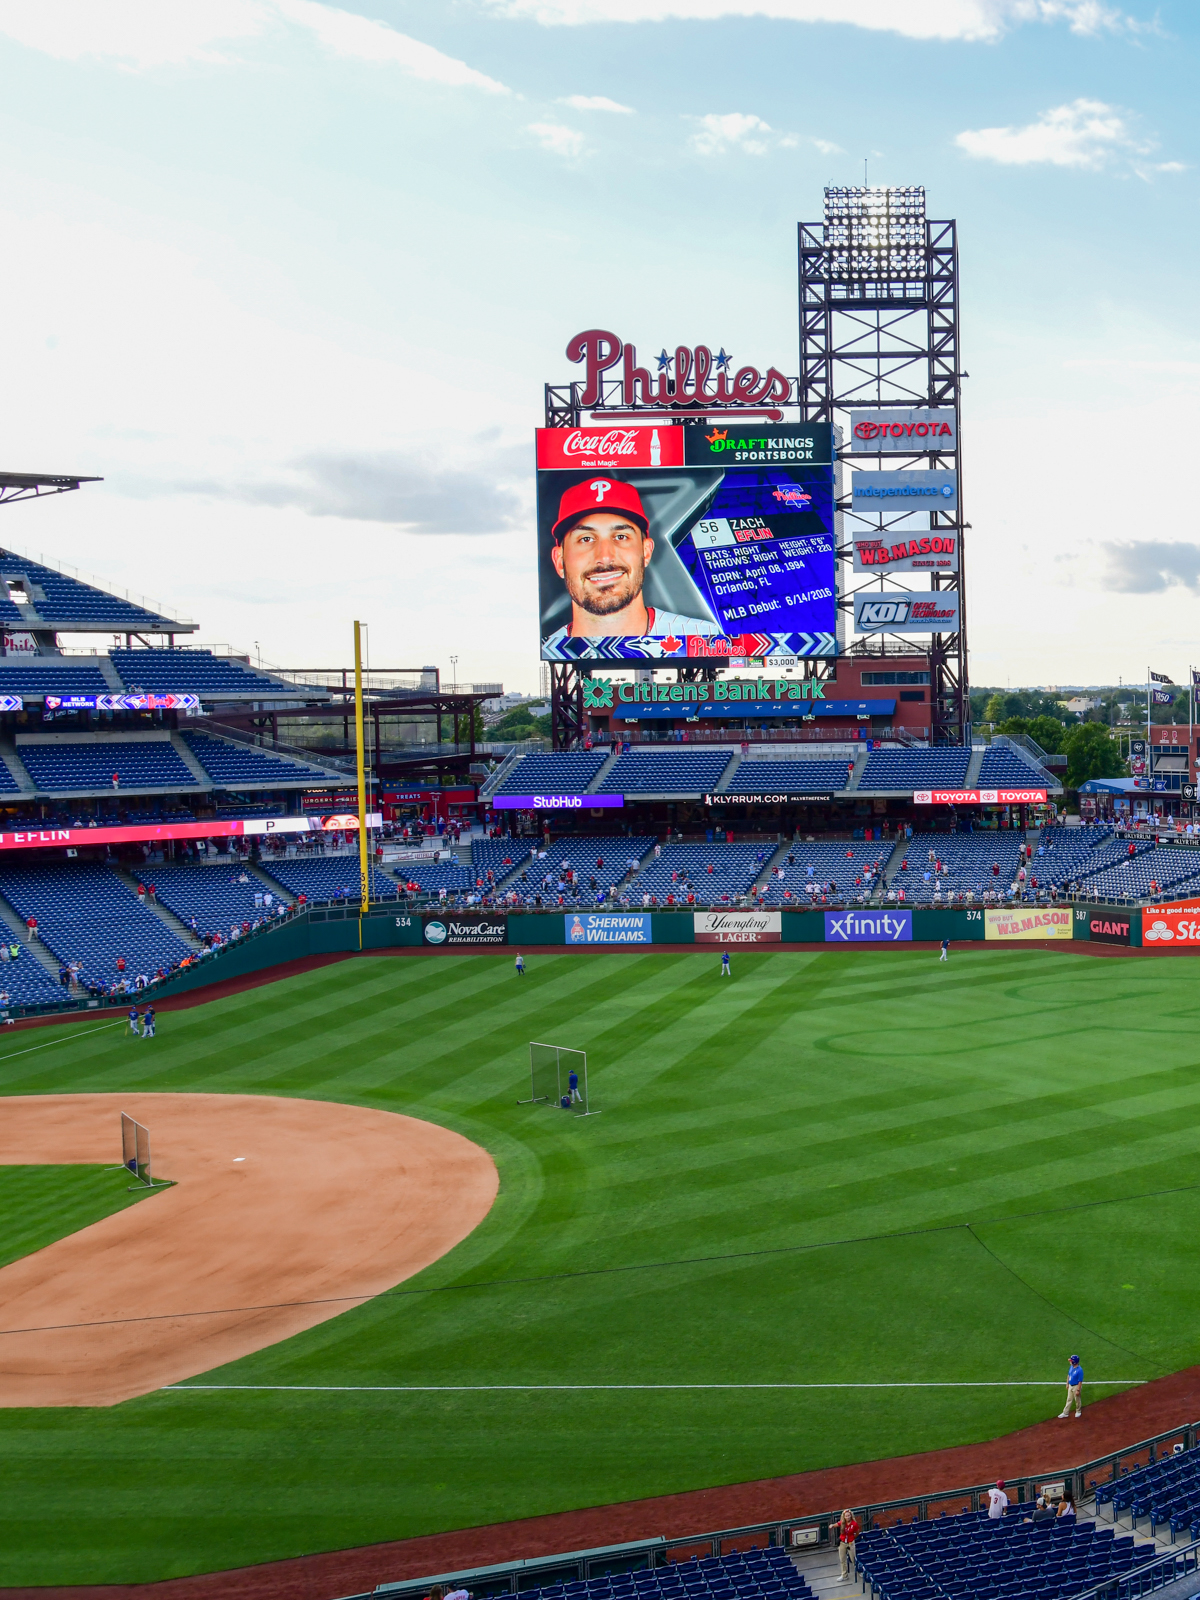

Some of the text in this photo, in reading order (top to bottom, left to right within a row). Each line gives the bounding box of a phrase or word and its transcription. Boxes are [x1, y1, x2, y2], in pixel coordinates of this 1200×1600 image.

[566, 329, 793, 406] Phillies
[879, 422, 952, 437] TOYOTA
[710, 437, 814, 453] DRAFTKINGS
[735, 451, 813, 460] SPORTSBOOK
[700, 521, 719, 534] 56
[730, 517, 765, 530] ZACH
[710, 535, 717, 544] P
[734, 527, 774, 542] EFLIN
[779, 539, 809, 550] HEIGHT:
[782, 544, 832, 558] WEIGHT: 220
[703, 545, 760, 561] BATS: RIGHT
[706, 551, 779, 570] THROWS: RIGHT
[711, 559, 806, 584] BORN: April 08, 1994
[715, 576, 772, 595] Orlando, FL
[723, 587, 833, 621] MLB Debut: 6/14/2016
[913, 602, 937, 610] OFFICE
[911, 609, 956, 618] TECHNOLOGY
[690, 635, 746, 657] Phillies
[768, 658, 795, 667] $3,000
[618, 677, 826, 702] Citizens Bank Park
[1154, 691, 1170, 702] 1950
[533, 796, 582, 808] StubHub
[713, 795, 788, 804] KLYRRUM.COM
[934, 792, 977, 801] TOYOTA
[1000, 792, 1043, 801] TOYOTA
[266, 821, 275, 832] P
[966, 911, 982, 921] 374
[1075, 911, 1087, 920] 387
[1166, 907, 1183, 915] good
[395, 917, 412, 927] 334
[587, 915, 644, 928] SHERWIN
[705, 914, 771, 931] Yuengling
[830, 913, 907, 940] xfinity
[447, 922, 505, 935] NovaCare
[1090, 920, 1130, 937] GIANT
[719, 933, 758, 942] LAGER
